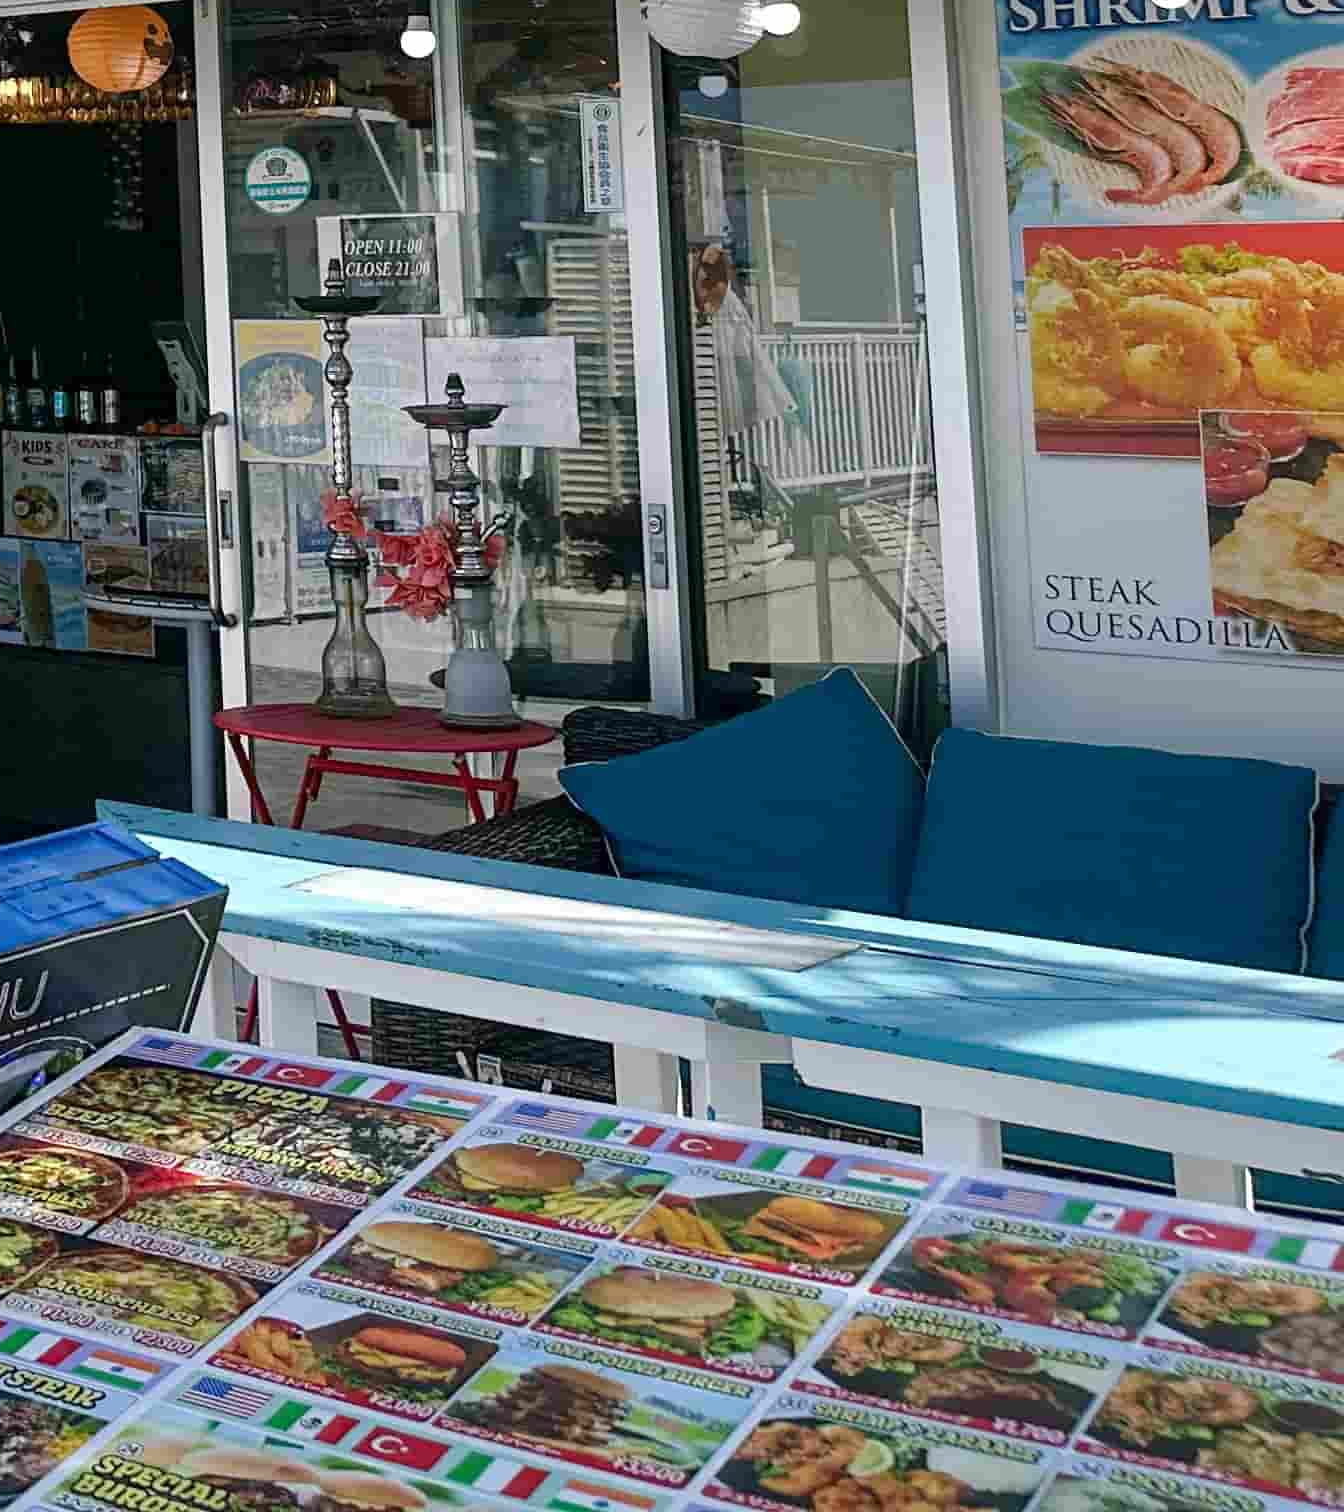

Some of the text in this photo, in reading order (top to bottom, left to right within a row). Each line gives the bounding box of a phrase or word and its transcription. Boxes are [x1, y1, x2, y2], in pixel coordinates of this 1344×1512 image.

[344, 238, 423, 256] OPEN 11:00
[344, 261, 392, 278] CLOSE
[21, 439, 53, 455] KIDS
[1044, 573, 1161, 608] STEAK
[1045, 608, 1290, 652] QUESADILLA
[211, 1079, 330, 1114] PIZZA
[515, 1132, 652, 1166] HAMBURGER
[643, 1254, 824, 1300] STEAK BURGER
[3, 1368, 108, 1411] STEAK
[663, 1365, 755, 1399] BURGER
[92, 1454, 230, 1512] SPECIAL
